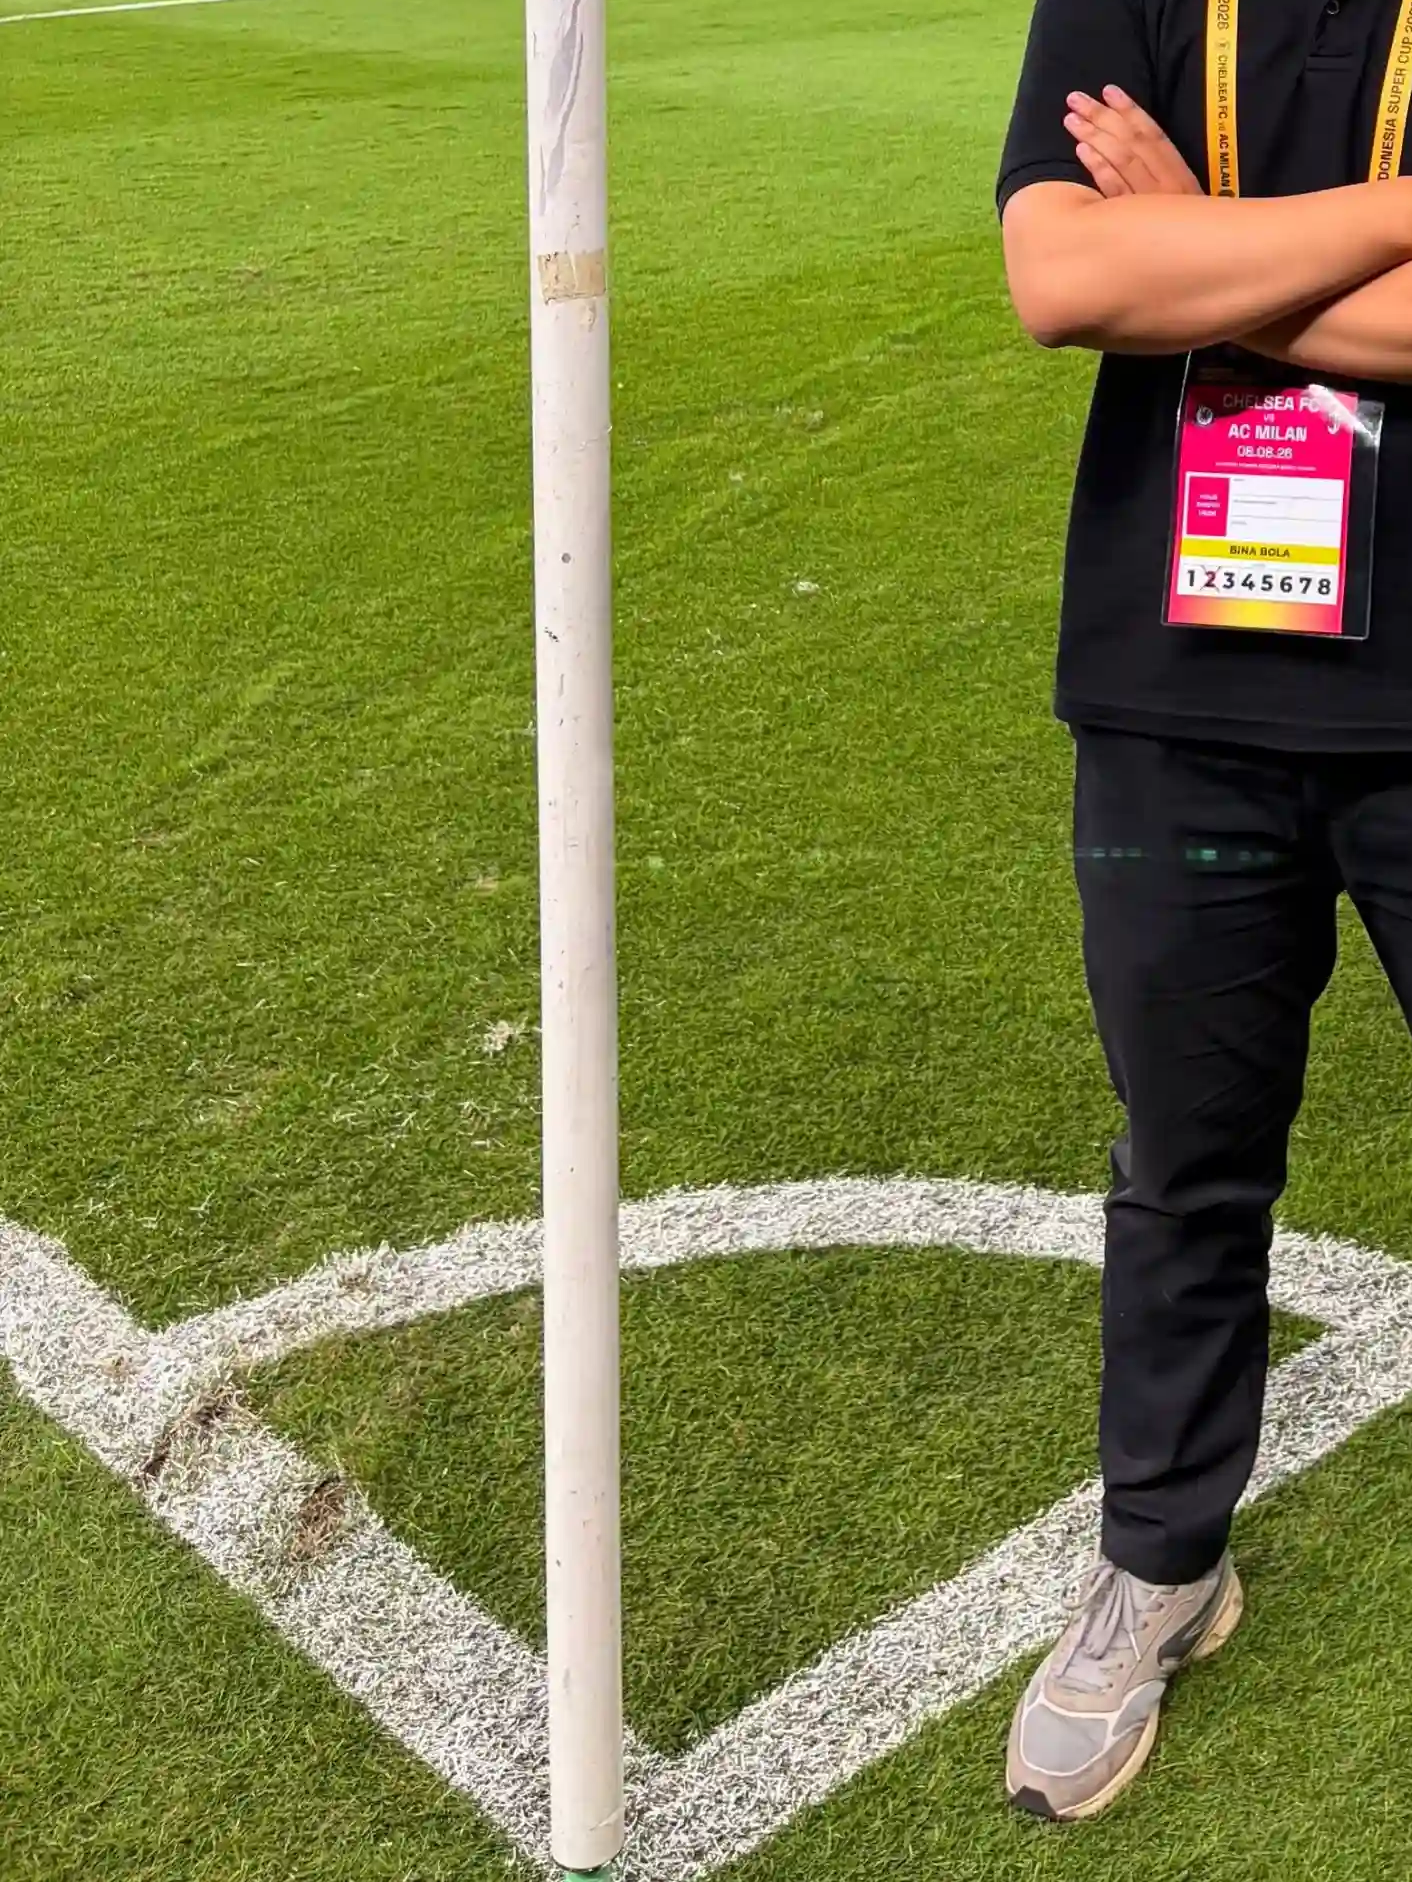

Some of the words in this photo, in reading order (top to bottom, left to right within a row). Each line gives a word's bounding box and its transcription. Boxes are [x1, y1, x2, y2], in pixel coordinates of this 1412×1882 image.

[1217, 55, 1228, 103] CHELSEA
[1387, 67, 1406, 115] SUPER
[1397, 38, 1412, 64] CUP
[1218, 105, 1228, 119] FC
[1219, 134, 1229, 149] AC
[1220, 152, 1231, 187] MILAN
[1223, 393, 1294, 411] CHELSEA
[1228, 423, 1251, 439] AC
[1255, 424, 1307, 442] MILAN
[1229, 545, 1256, 557] BINA
[1260, 546, 1290, 558] BOLA
